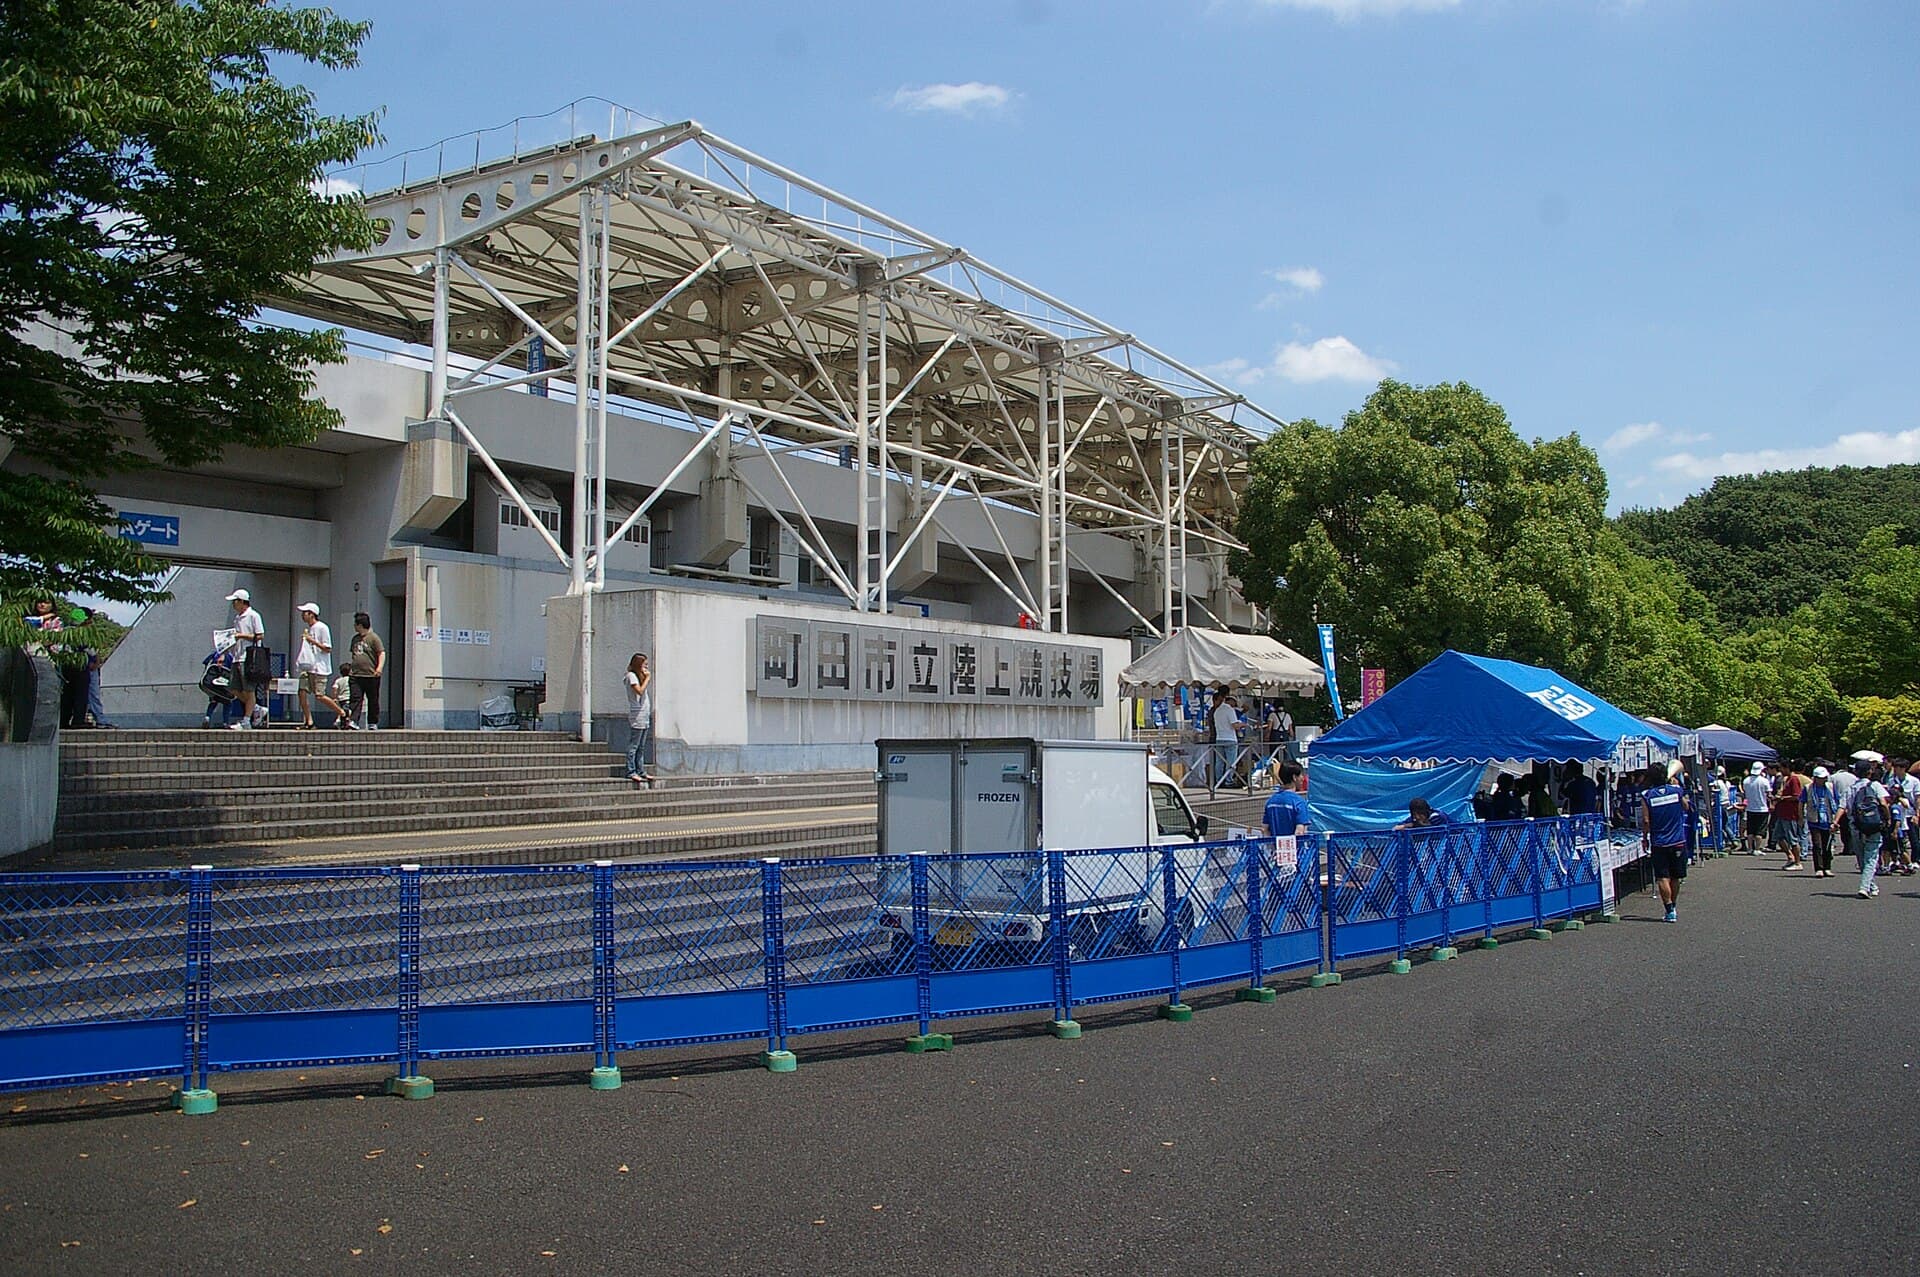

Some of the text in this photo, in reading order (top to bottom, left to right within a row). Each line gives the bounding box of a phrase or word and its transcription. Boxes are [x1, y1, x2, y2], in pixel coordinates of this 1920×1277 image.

[120, 519, 178, 539] Aゲート
[764, 626, 1100, 699] 町田市立陸上競技場
[977, 793, 1020, 802] FROZEN
